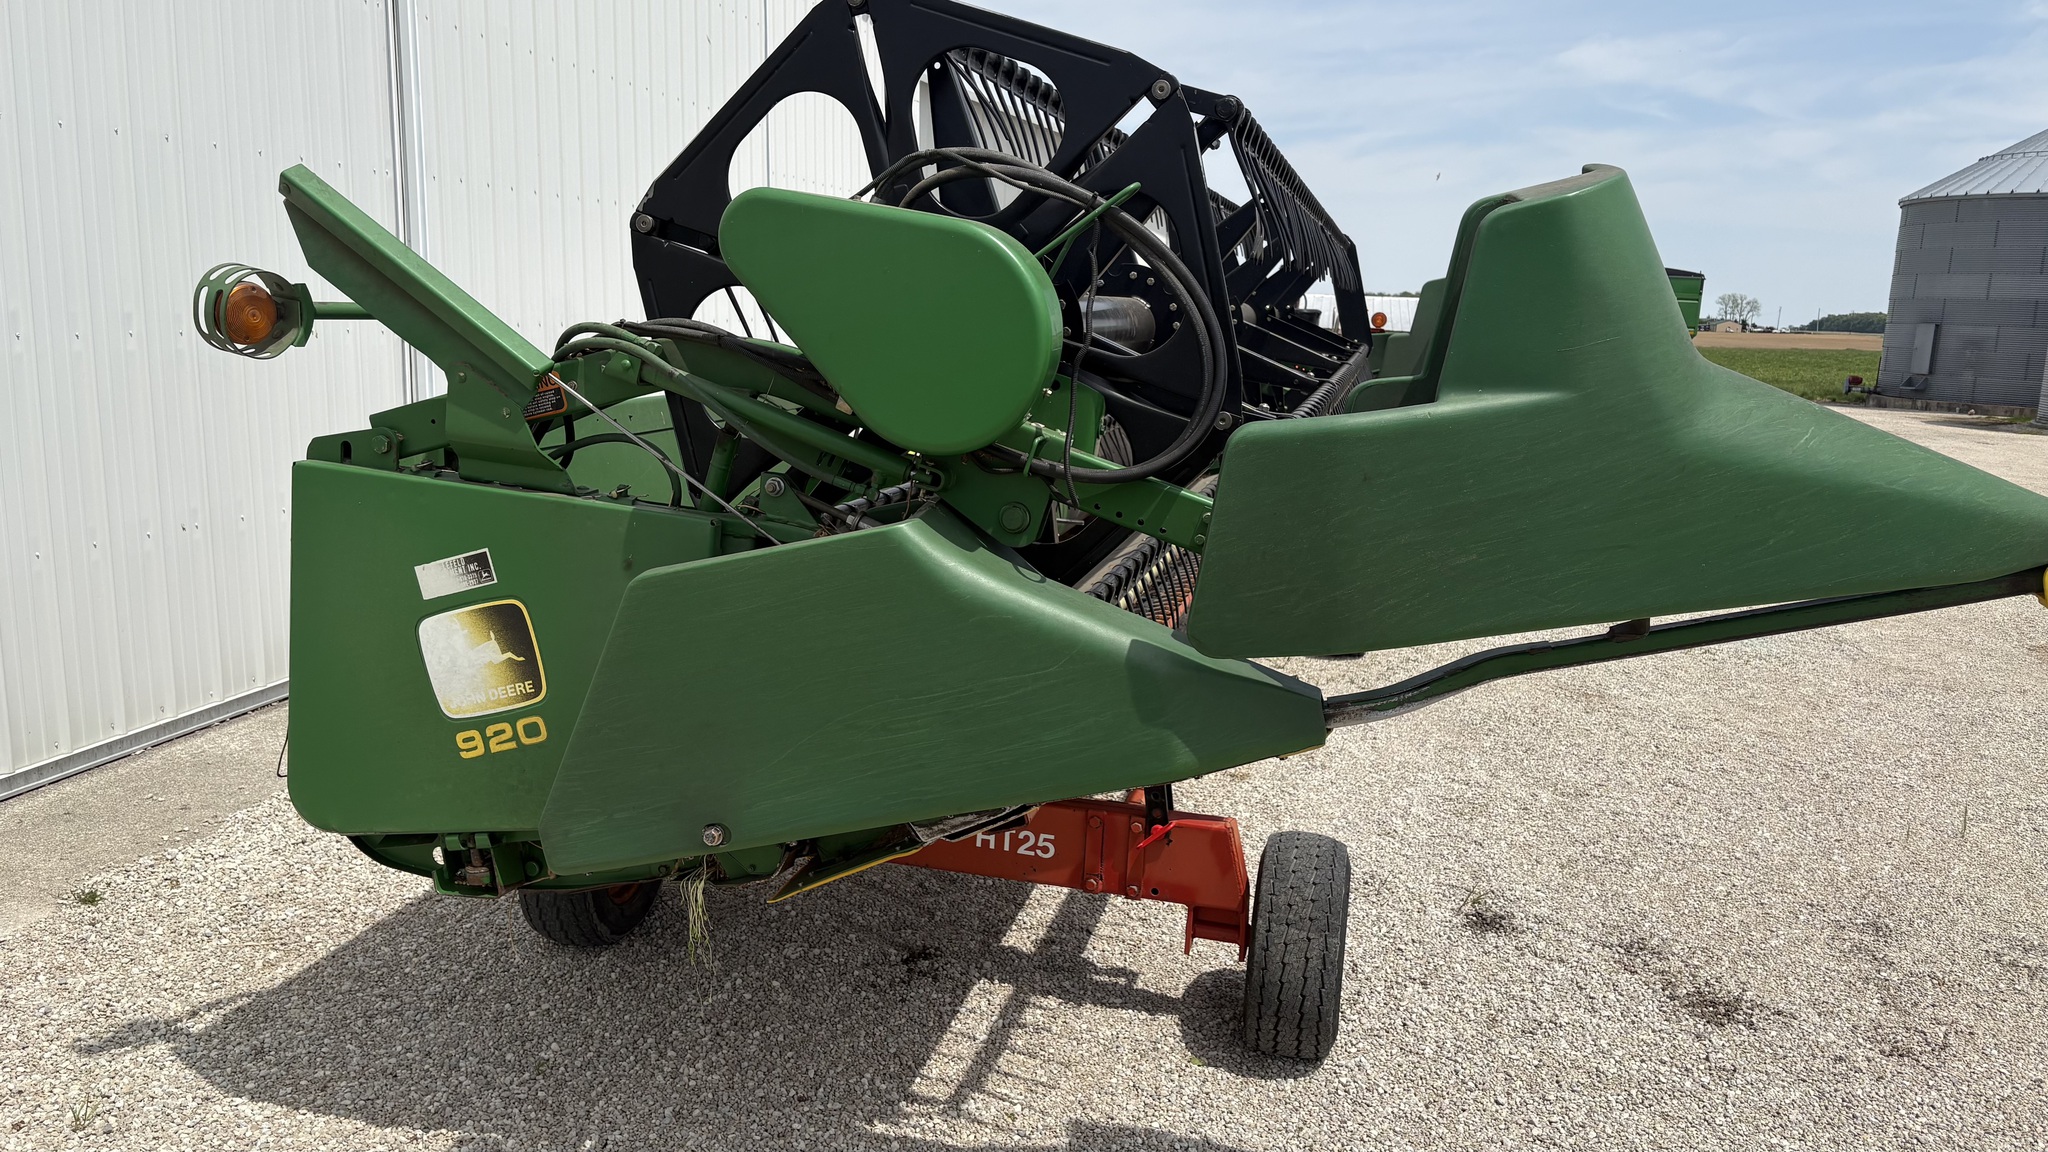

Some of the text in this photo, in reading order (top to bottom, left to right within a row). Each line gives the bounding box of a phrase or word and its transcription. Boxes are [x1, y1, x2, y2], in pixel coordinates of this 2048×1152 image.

[467, 562, 482, 572] INC.
[488, 680, 536, 701] DEERE
[455, 715, 548, 759] 920
[976, 830, 1056, 859] HT25
